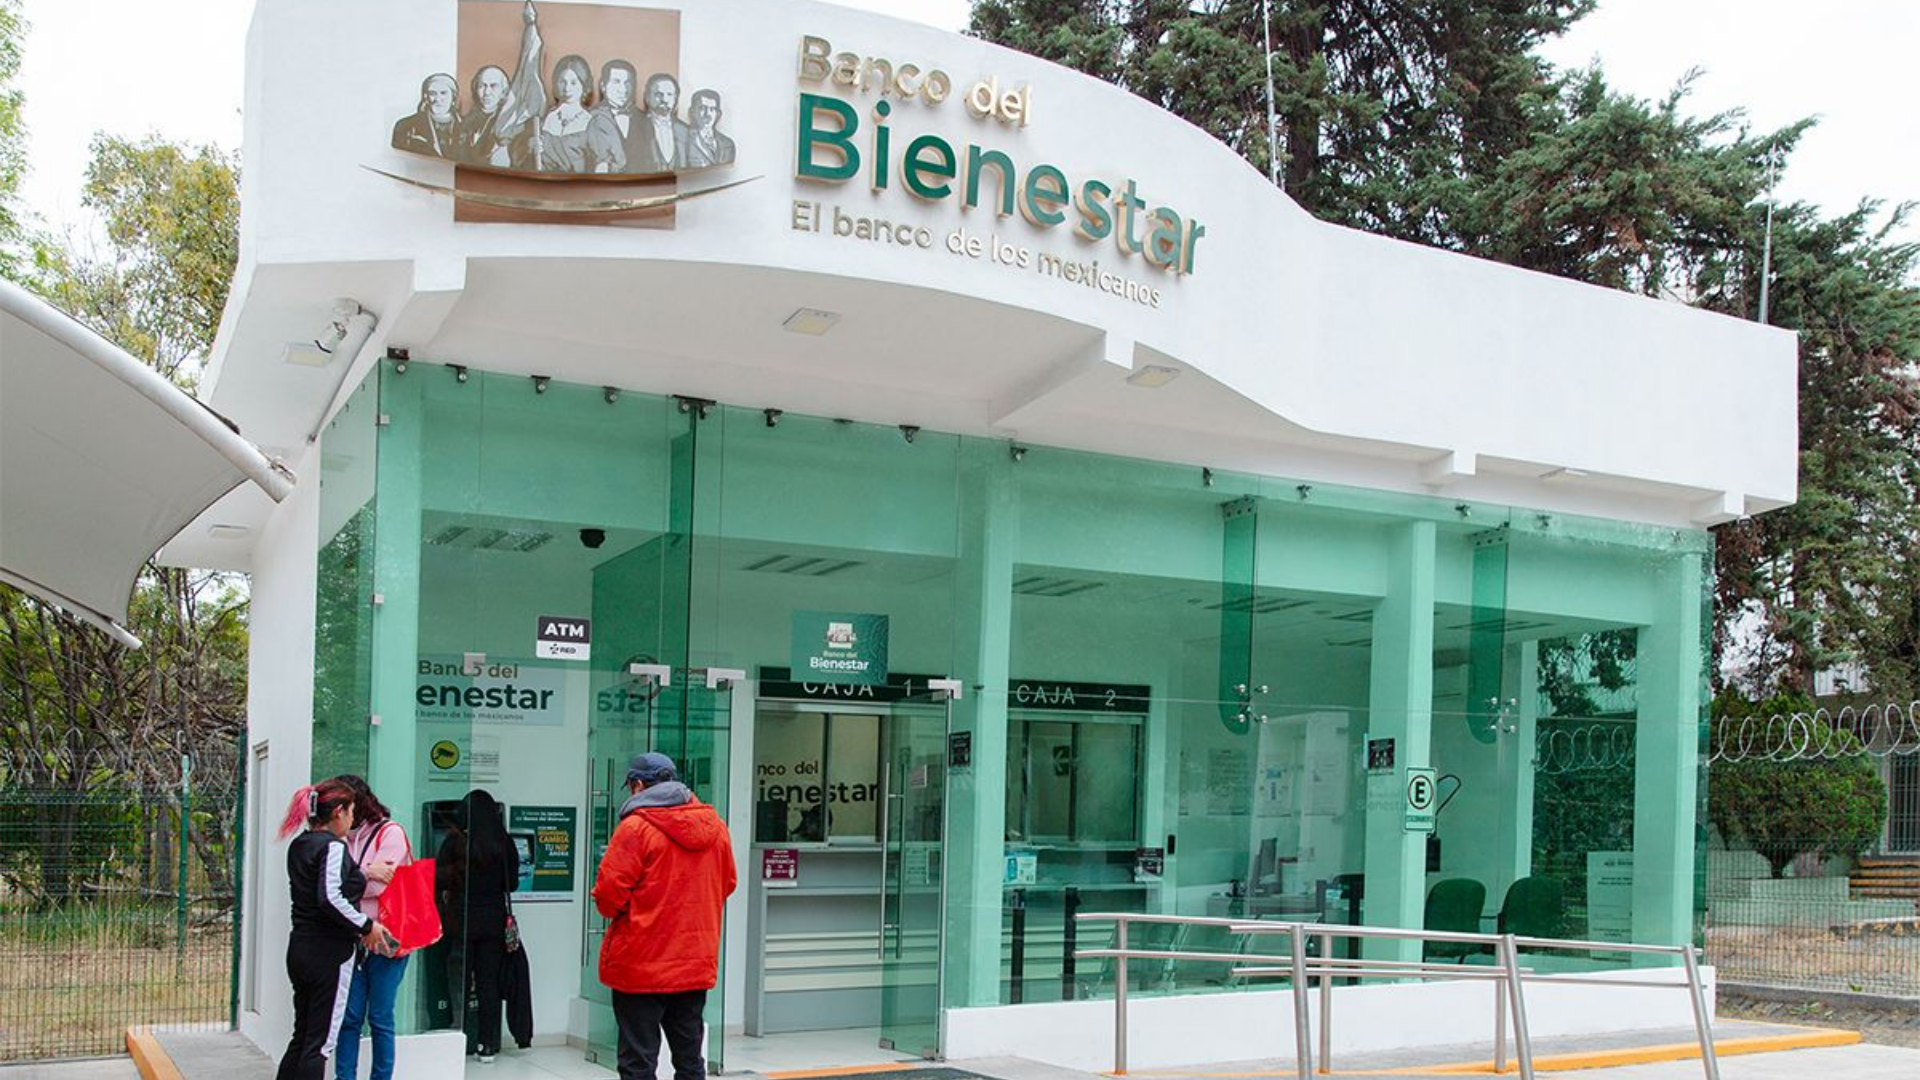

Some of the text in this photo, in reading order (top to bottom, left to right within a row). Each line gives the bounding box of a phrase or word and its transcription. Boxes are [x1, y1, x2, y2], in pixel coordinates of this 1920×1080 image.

[799, 35, 1031, 127] Banco del
[796, 93, 1205, 275] Bienestar
[792, 201, 1161, 308] El banco de los mexicanos
[544, 623, 584, 637] ATM
[488, 663, 518, 679] del
[810, 656, 869, 670] Bienestar
[904, 679, 911, 697] 1
[1017, 684, 1116, 706] CAJA 2
[795, 760, 818, 774] del
[1415, 781, 1425, 803] E
